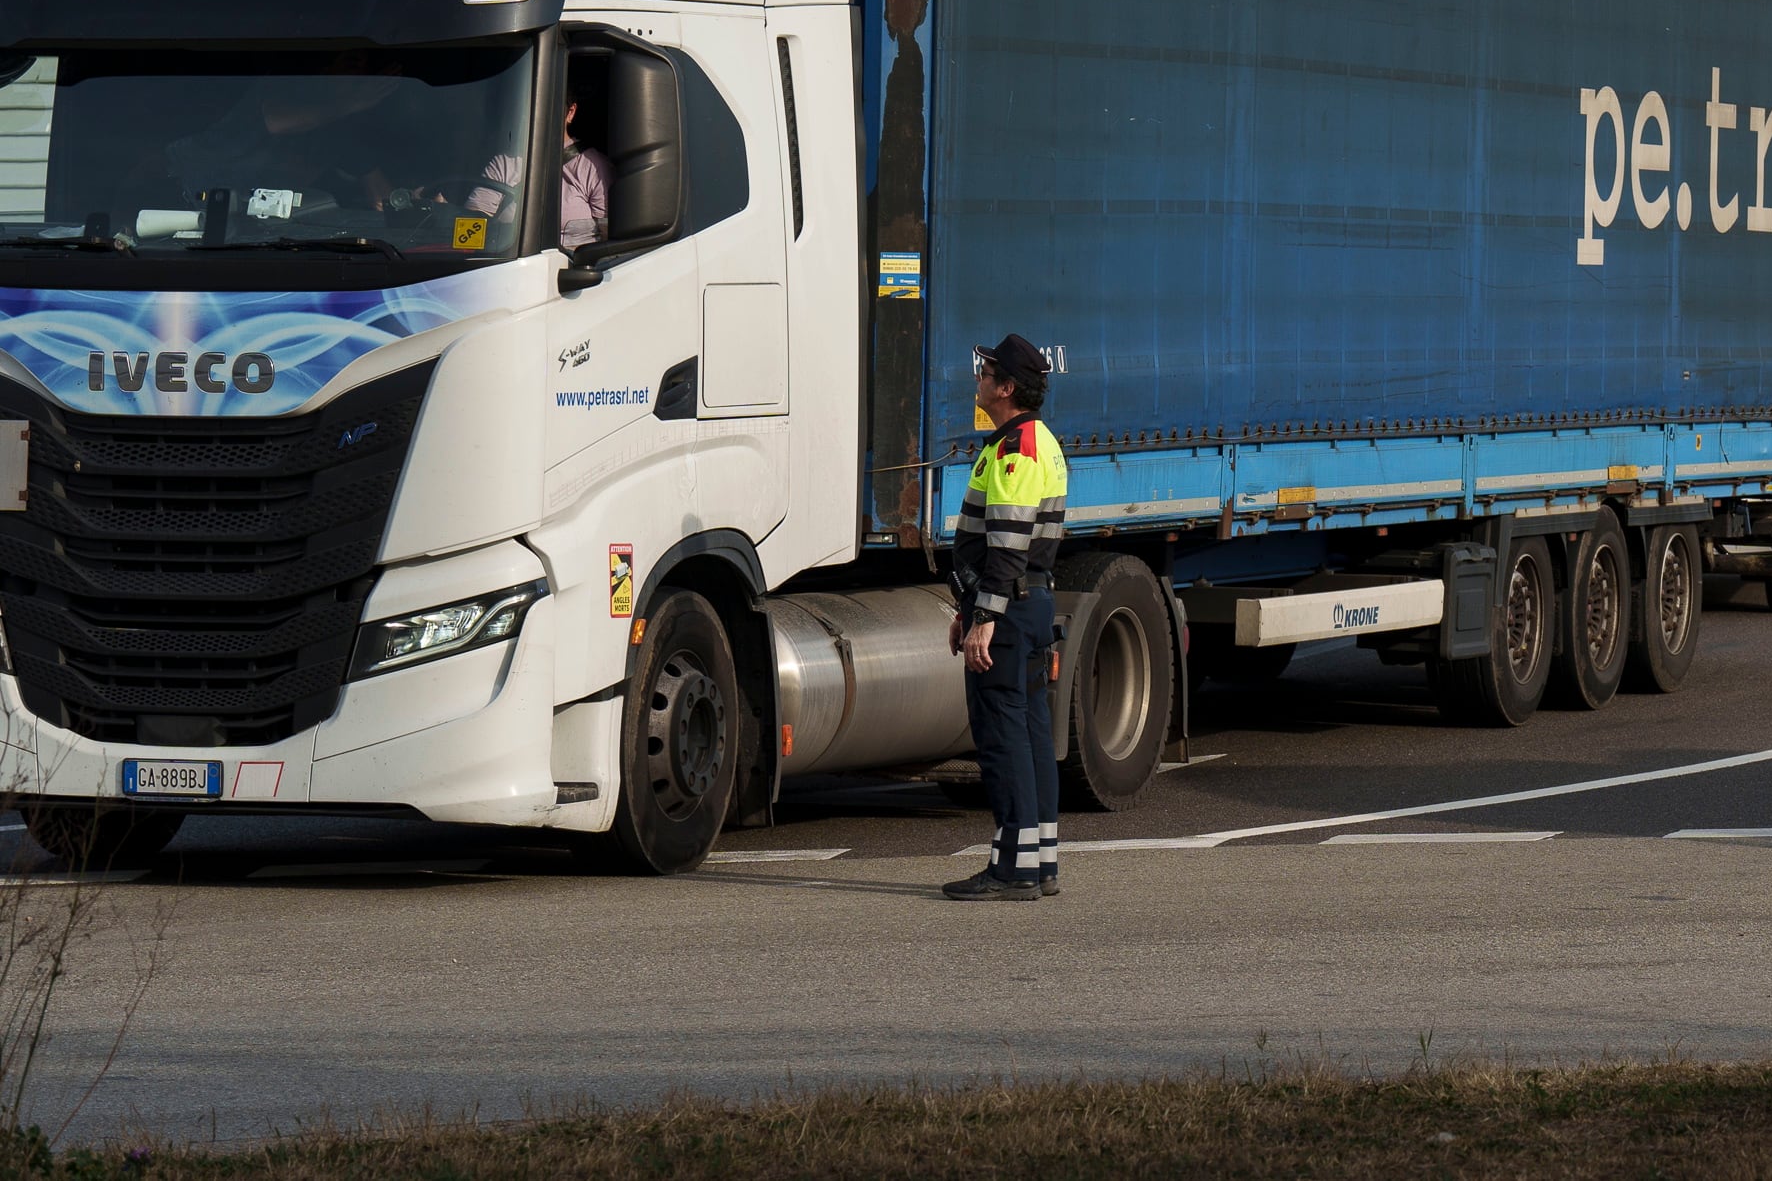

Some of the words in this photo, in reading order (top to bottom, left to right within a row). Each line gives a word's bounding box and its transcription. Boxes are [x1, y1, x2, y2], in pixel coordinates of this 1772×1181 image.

[458, 221, 482, 244] GAS
[88, 350, 275, 393] IVECO
[556, 385, 649, 411] www.petrasrl.net
[1344, 606, 1379, 628] KRONE
